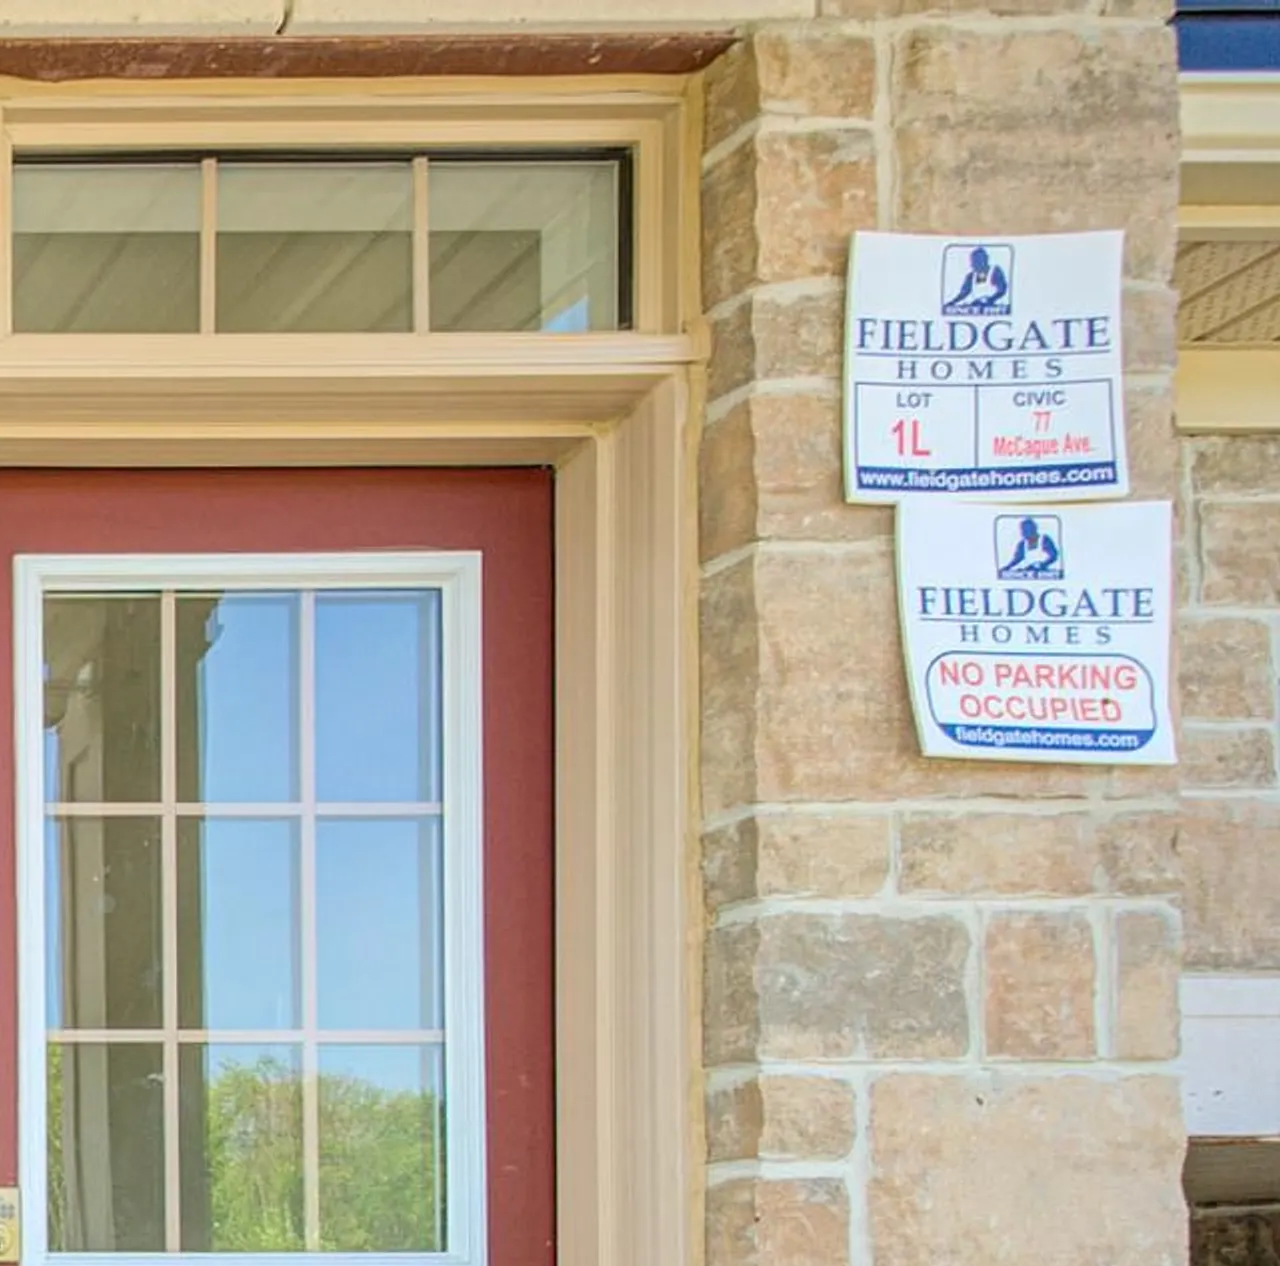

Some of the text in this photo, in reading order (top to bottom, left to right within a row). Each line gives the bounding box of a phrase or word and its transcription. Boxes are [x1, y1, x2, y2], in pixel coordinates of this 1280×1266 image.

[856, 316, 1111, 351] FIELDGATE
[897, 358, 1063, 380] HOMES
[896, 392, 933, 408] LOT
[1013, 390, 1066, 407] CIVIC
[1032, 411, 1052, 432] 77
[891, 418, 931, 457] 1L
[993, 435, 1058, 459] McCague
[859, 464, 1114, 490] www.fieldgatehomes.com
[917, 586, 1154, 618] FIELDGATE
[959, 624, 1113, 644] HOMES
[939, 660, 1137, 690] NO PARKING
[959, 693, 1122, 722] OCCUPIED
[955, 725, 1139, 748] fieldgatehomes.com
